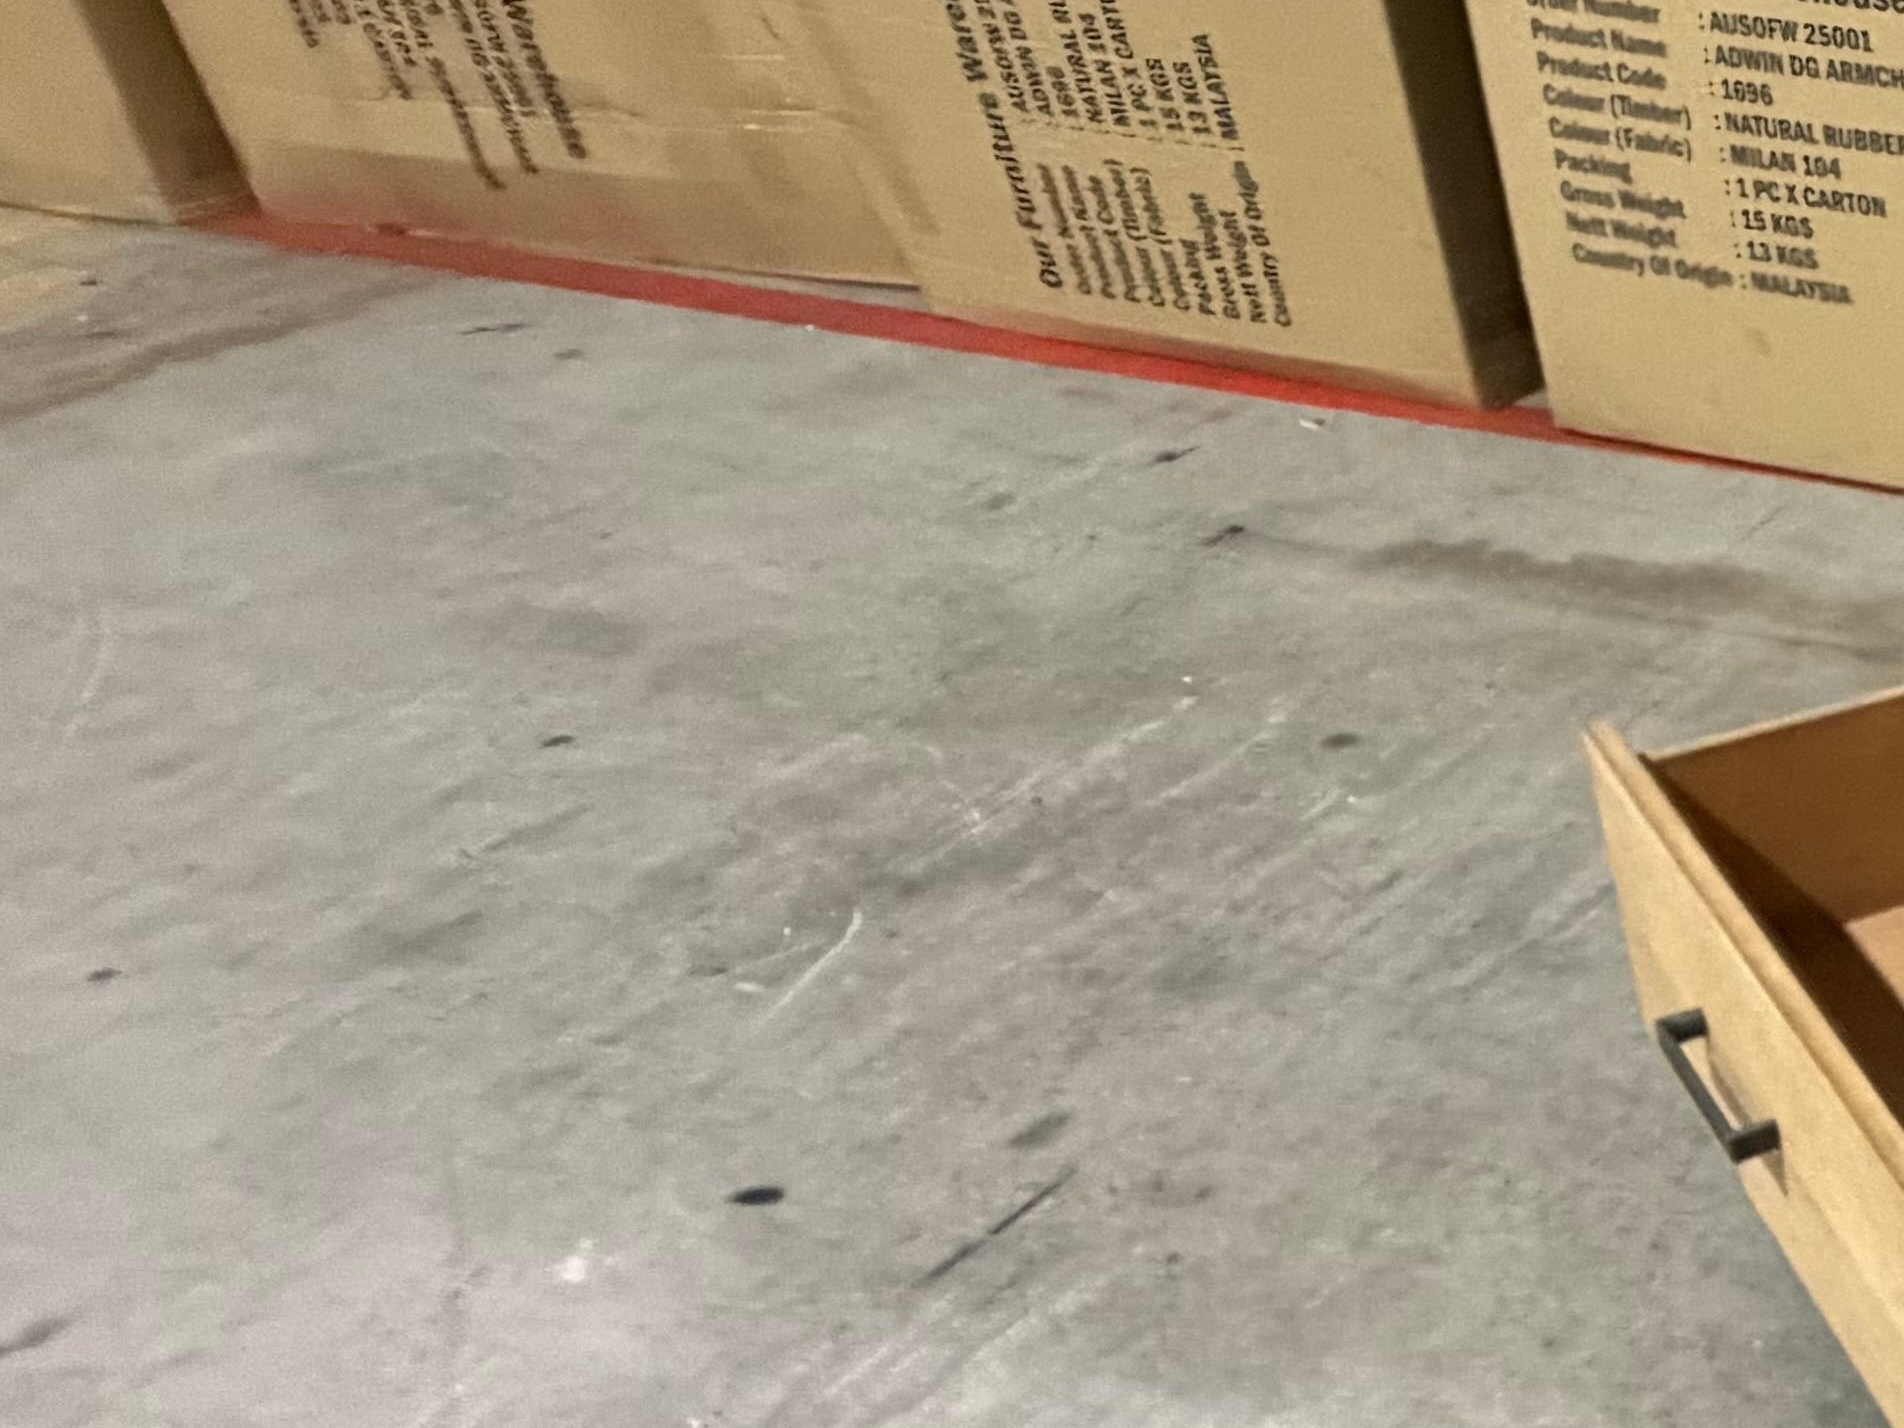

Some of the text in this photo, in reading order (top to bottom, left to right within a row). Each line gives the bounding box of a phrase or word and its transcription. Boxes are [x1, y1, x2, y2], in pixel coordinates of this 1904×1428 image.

[1710, 11, 1872, 52] AUSOFW 25001
[1737, 178, 1886, 218] 1 PC X CARTON
